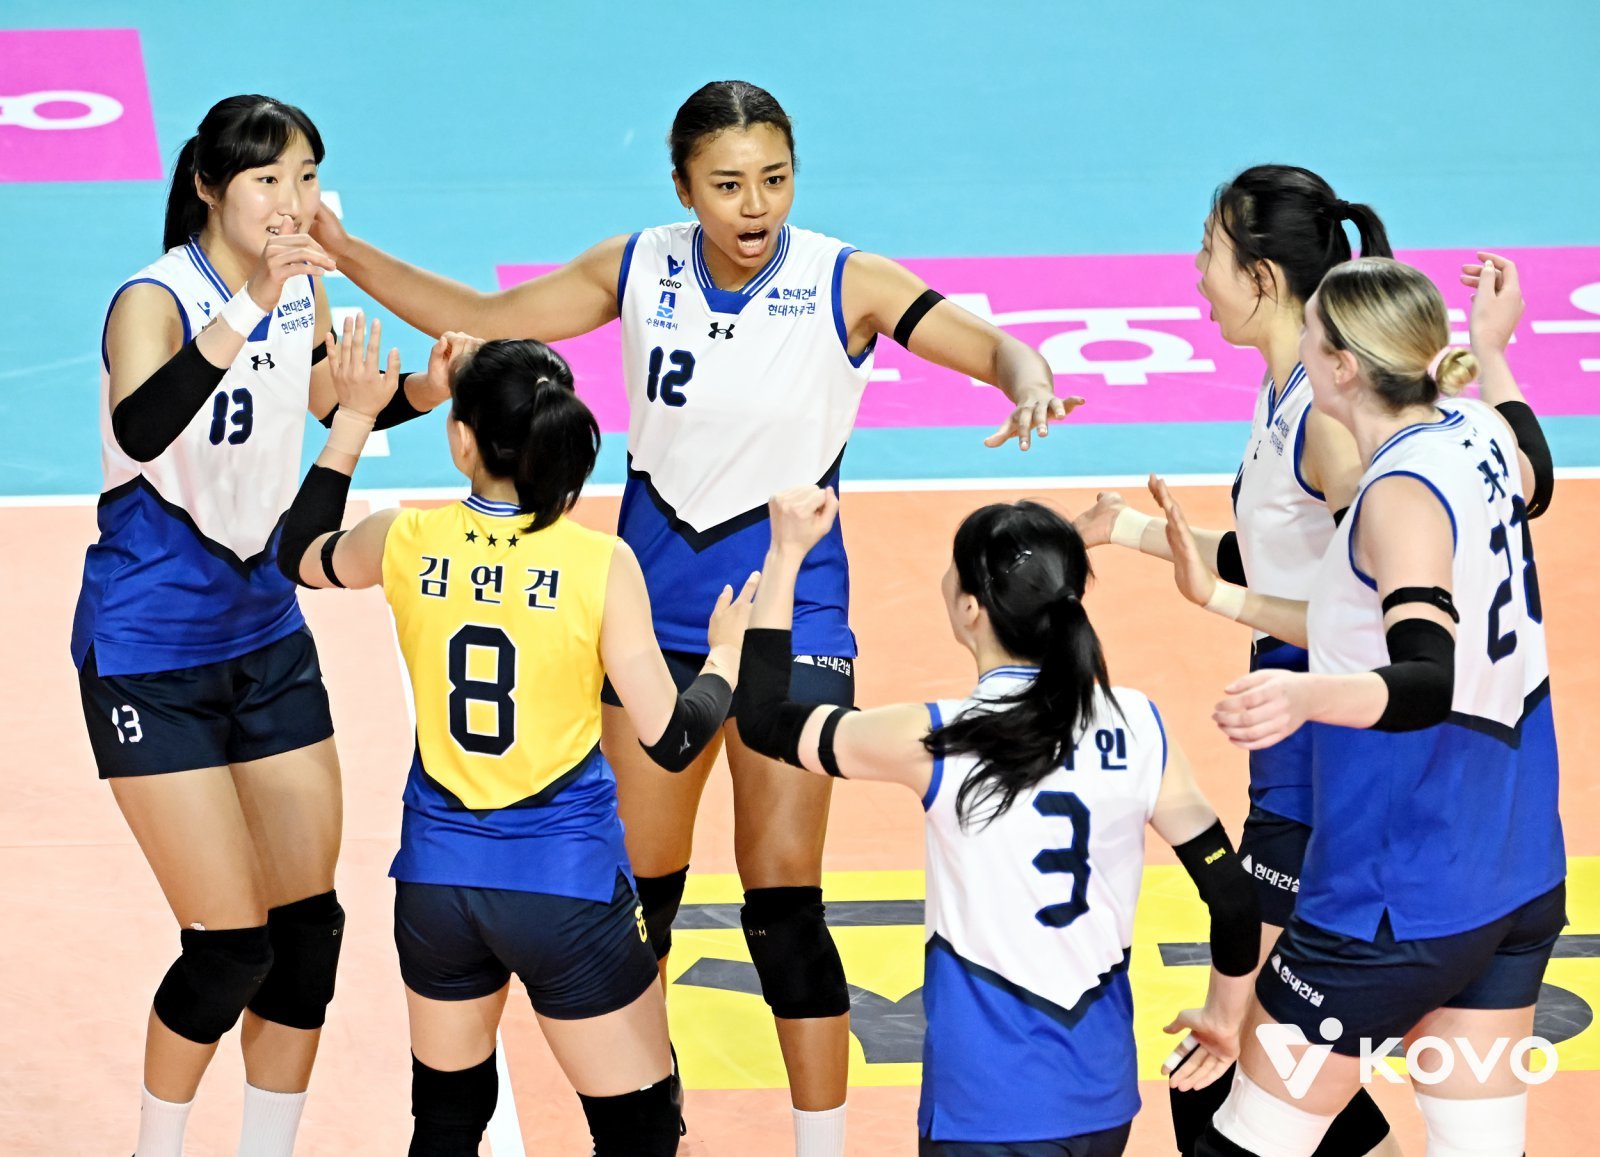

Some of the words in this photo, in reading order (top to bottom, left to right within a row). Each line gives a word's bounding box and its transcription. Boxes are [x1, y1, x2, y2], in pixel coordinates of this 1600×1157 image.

[282, 297, 312, 315] 현대건설
[659, 278, 682, 289] KOVO
[647, 346, 696, 407] 12
[209, 388, 253, 445] 13
[418, 556, 560, 610] 김연견
[447, 623, 517, 757] 8
[111, 704, 143, 744] 13
[1032, 790, 1091, 929] 3
[1280, 965, 1325, 1008] 현대건설
